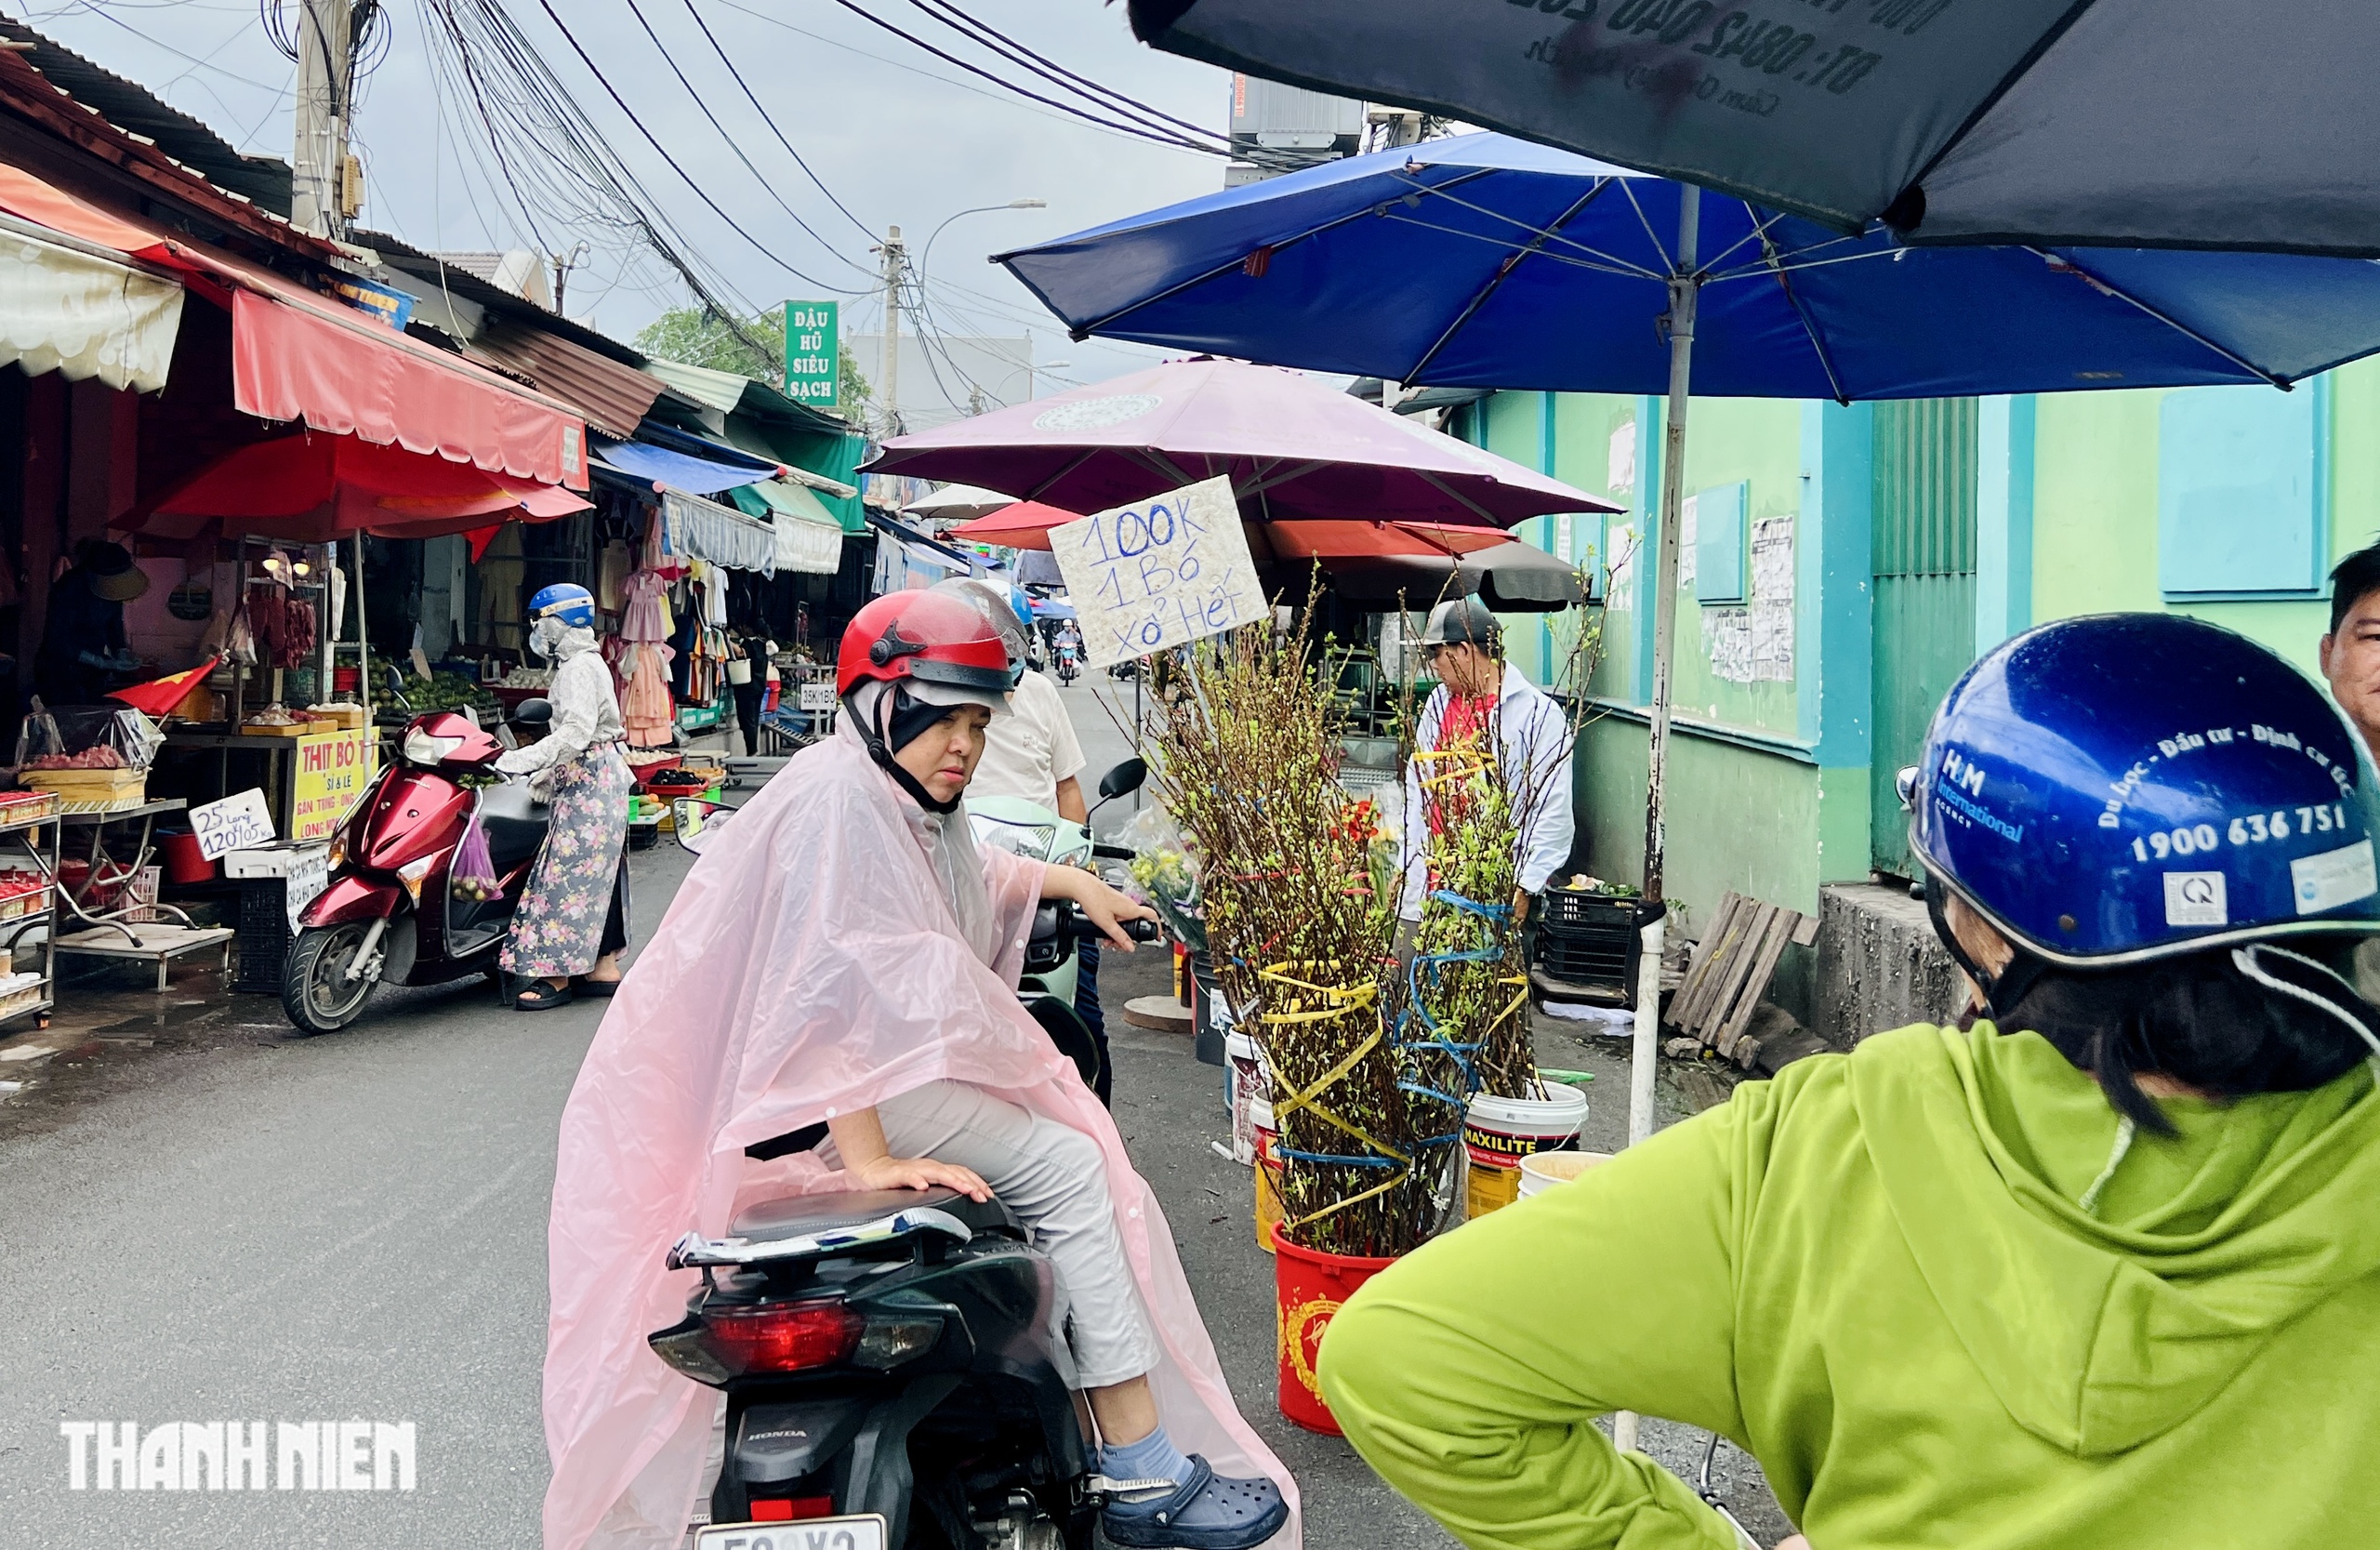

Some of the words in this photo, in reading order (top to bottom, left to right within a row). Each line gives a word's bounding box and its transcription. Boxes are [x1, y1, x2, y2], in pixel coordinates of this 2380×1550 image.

[794, 307, 828, 331] ĐẬU
[800, 330, 823, 351] HŨ
[793, 353, 829, 374] SIÊU
[790, 381, 831, 401] SẠCH
[1097, 567, 1136, 612] 1
[336, 733, 355, 767] BÒ
[2109, 761, 2150, 798] học
[1937, 775, 2025, 843] International
[2097, 798, 2122, 829] Du
[2130, 824, 2220, 862] 1900
[2228, 810, 2290, 845] 636
[2294, 803, 2347, 834] 751
[1464, 1127, 1537, 1154] MAXILITE
[747, 1429, 808, 1441] HONDA
